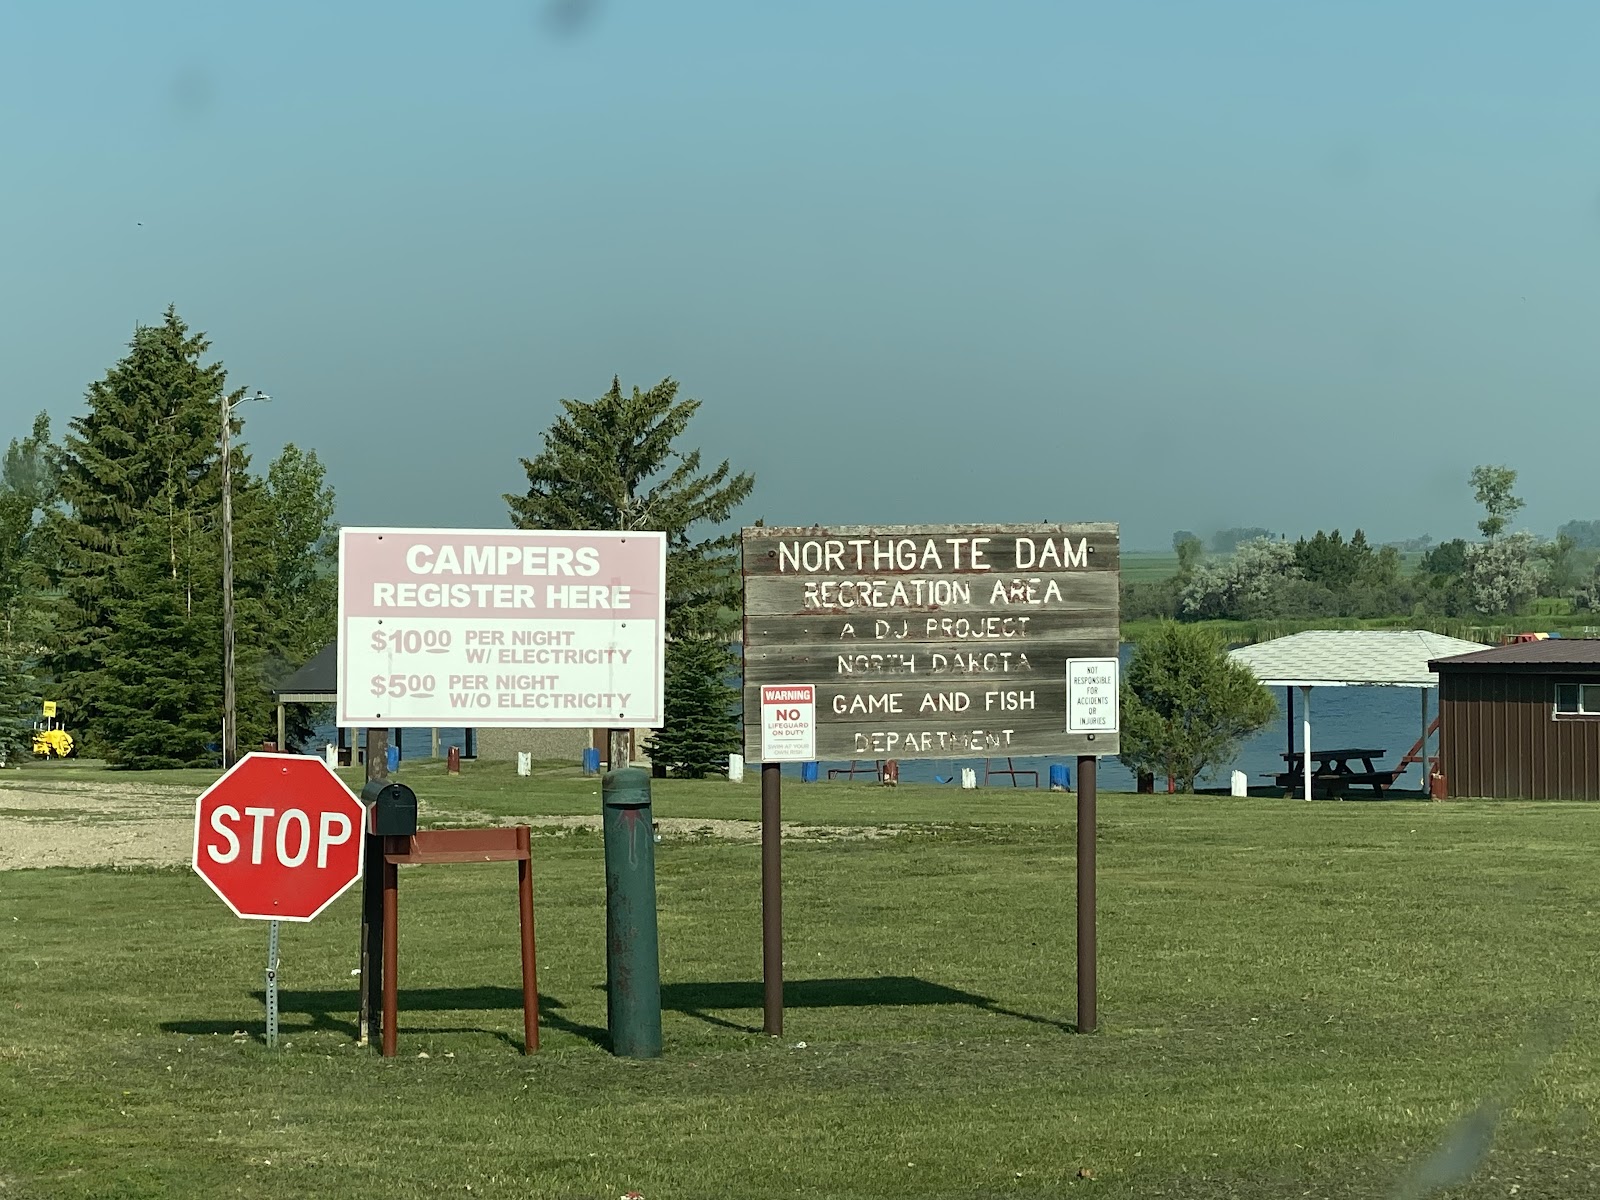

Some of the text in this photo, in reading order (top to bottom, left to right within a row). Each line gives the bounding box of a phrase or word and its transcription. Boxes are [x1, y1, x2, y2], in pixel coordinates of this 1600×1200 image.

[406, 544, 600, 576] CAMPERS
[779, 537, 1087, 572] NORTHGATE DAM
[373, 583, 631, 609] REGISTER HERE
[804, 579, 1062, 608] RECREATION AREA
[839, 617, 1031, 639] A DJ PROJECT
[465, 630, 505, 646] PER
[512, 630, 575, 646] NIGHT
[465, 649, 632, 664] W/ ELECTRICITY
[837, 653, 1032, 674] NORTH DAKOTA
[1087, 666, 1098, 674] NOT
[449, 675, 489, 690] PER
[495, 675, 559, 690] NIGHT
[1074, 676, 1111, 684] RESPONSIBLE
[449, 693, 631, 708] W/O ELECTRICITY
[765, 690, 810, 700] WARNING
[833, 690, 1035, 714] GAME AND FISH
[1077, 697, 1108, 705] ACCIDENTS
[777, 709, 800, 721] NO
[1089, 707, 1096, 715] OR
[1080, 717, 1106, 725] INJURIES
[854, 729, 1015, 752] DEPARTMENT
[206, 805, 352, 868] STOP
